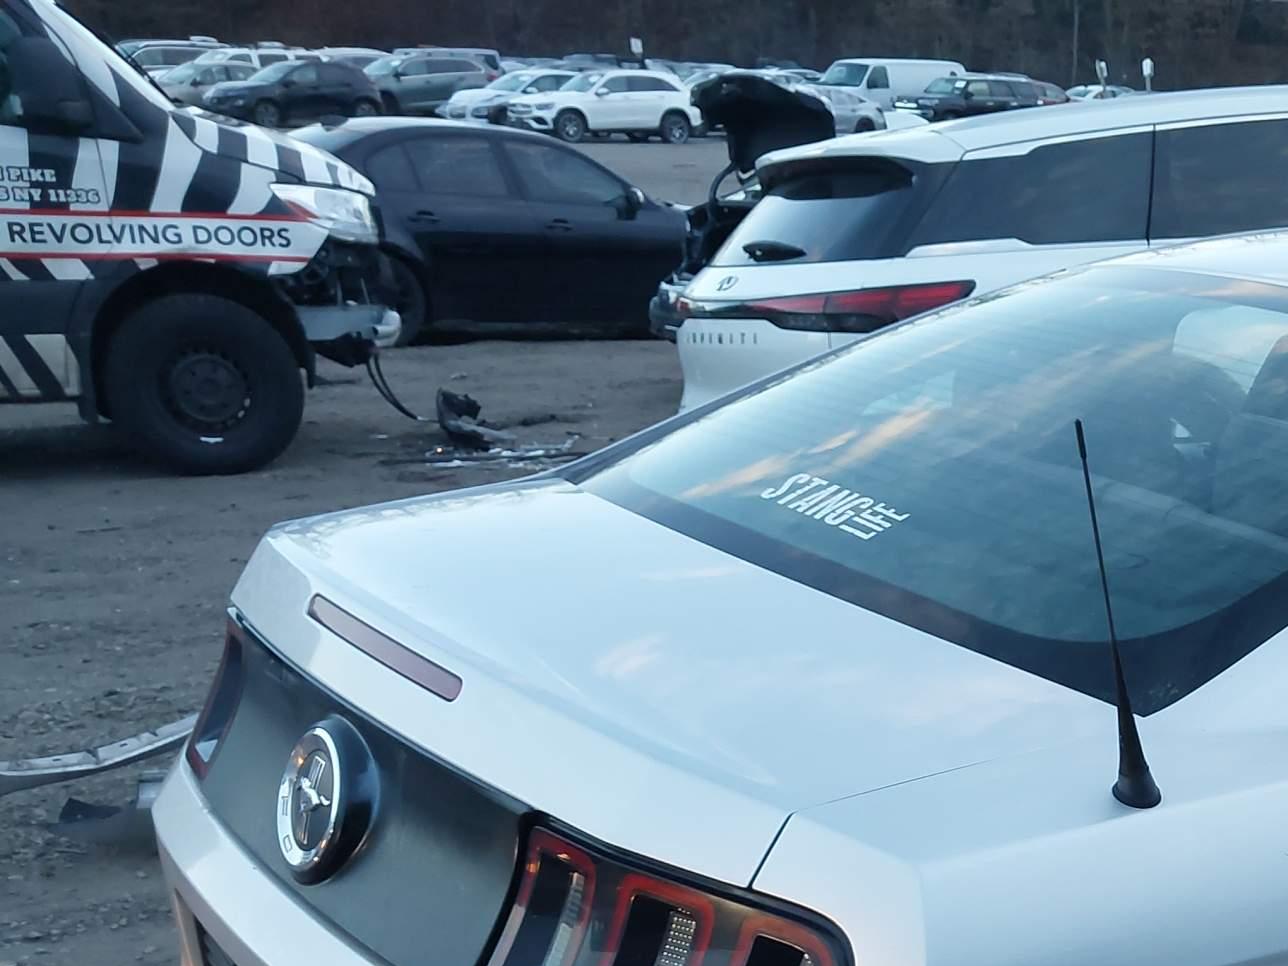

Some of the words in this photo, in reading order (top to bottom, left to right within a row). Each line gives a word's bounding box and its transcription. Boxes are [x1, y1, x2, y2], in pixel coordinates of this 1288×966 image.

[7, 167, 56, 182] PIKE
[13, 188, 42, 202] NY
[7, 221, 183, 245] REVOLVING
[193, 224, 292, 249] DOORS
[760, 472, 875, 526] STANG
[838, 502, 911, 540] LIFE
